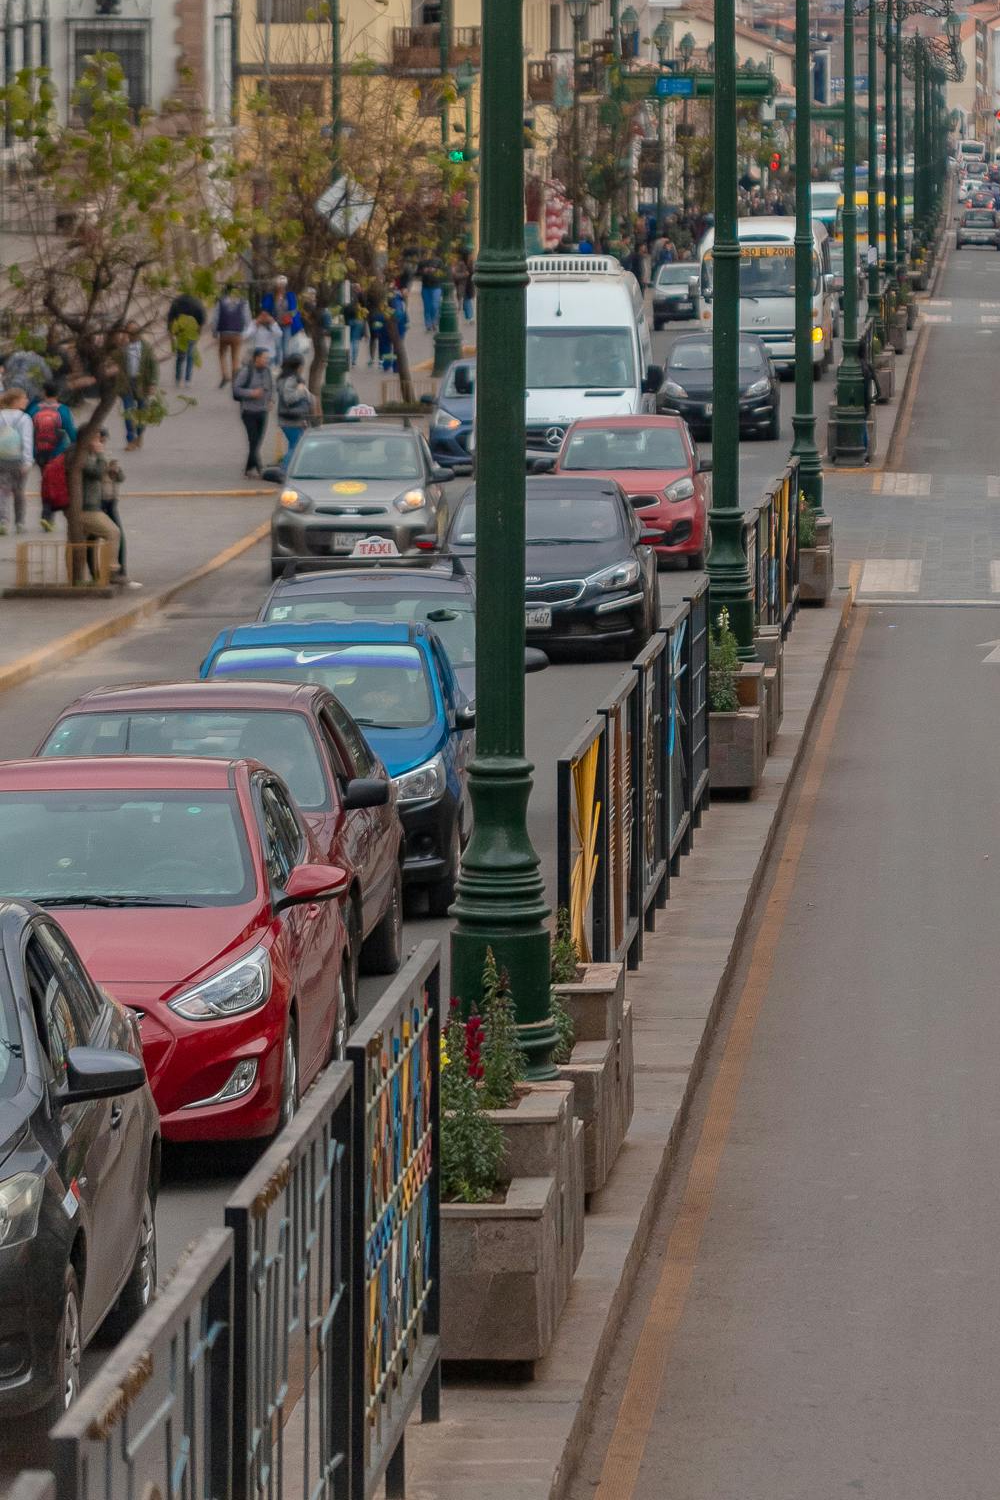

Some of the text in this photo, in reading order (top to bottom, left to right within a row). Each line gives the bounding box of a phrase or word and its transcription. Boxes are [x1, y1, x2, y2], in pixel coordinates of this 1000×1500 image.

[772, 247, 795, 256] ZORR
[359, 543, 392, 554] TAXI
[526, 612, 550, 625] T-467
